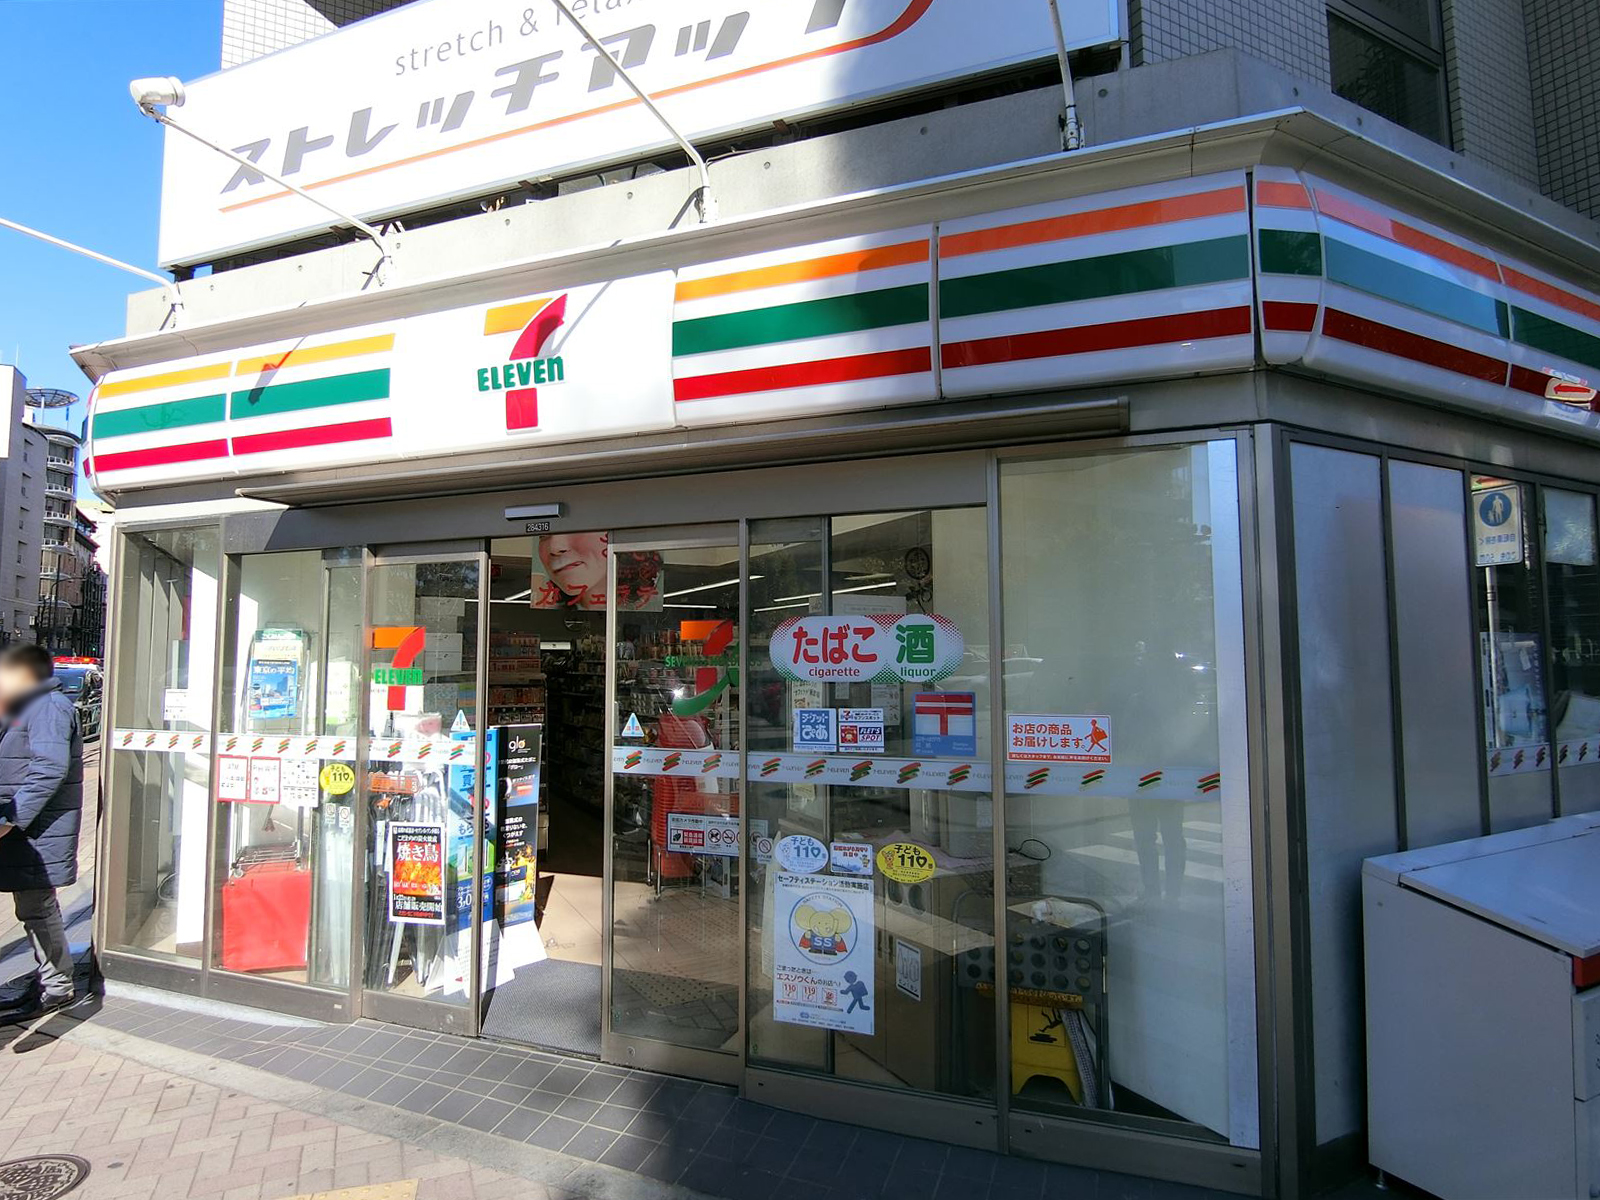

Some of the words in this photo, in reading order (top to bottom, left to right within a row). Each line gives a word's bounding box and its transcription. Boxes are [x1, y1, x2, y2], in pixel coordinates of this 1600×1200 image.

[395, 20, 503, 76] stretch
[519, 8, 539, 36] &
[556, 0, 632, 27] rela
[219, 0, 847, 194] ストレッチアッ
[526, 522, 550, 533] 284316
[792, 623, 878, 665] たばこ
[895, 623, 936, 664] 酒
[808, 666, 861, 679] cigarette
[900, 666, 937, 679] liquor
[801, 713, 829, 723] チケット
[801, 724, 829, 740] ぴあ
[1012, 722, 1073, 736] お店の商品
[508, 735, 526, 753] glo
[1012, 735, 1086, 749] お届けします。
[790, 836, 815, 847] 子ども
[396, 841, 439, 863] 焼き鳥
[894, 844, 921, 856] 子ども
[813, 936, 833, 947] SS
[784, 983, 797, 992] 110
[804, 986, 816, 995] 119
